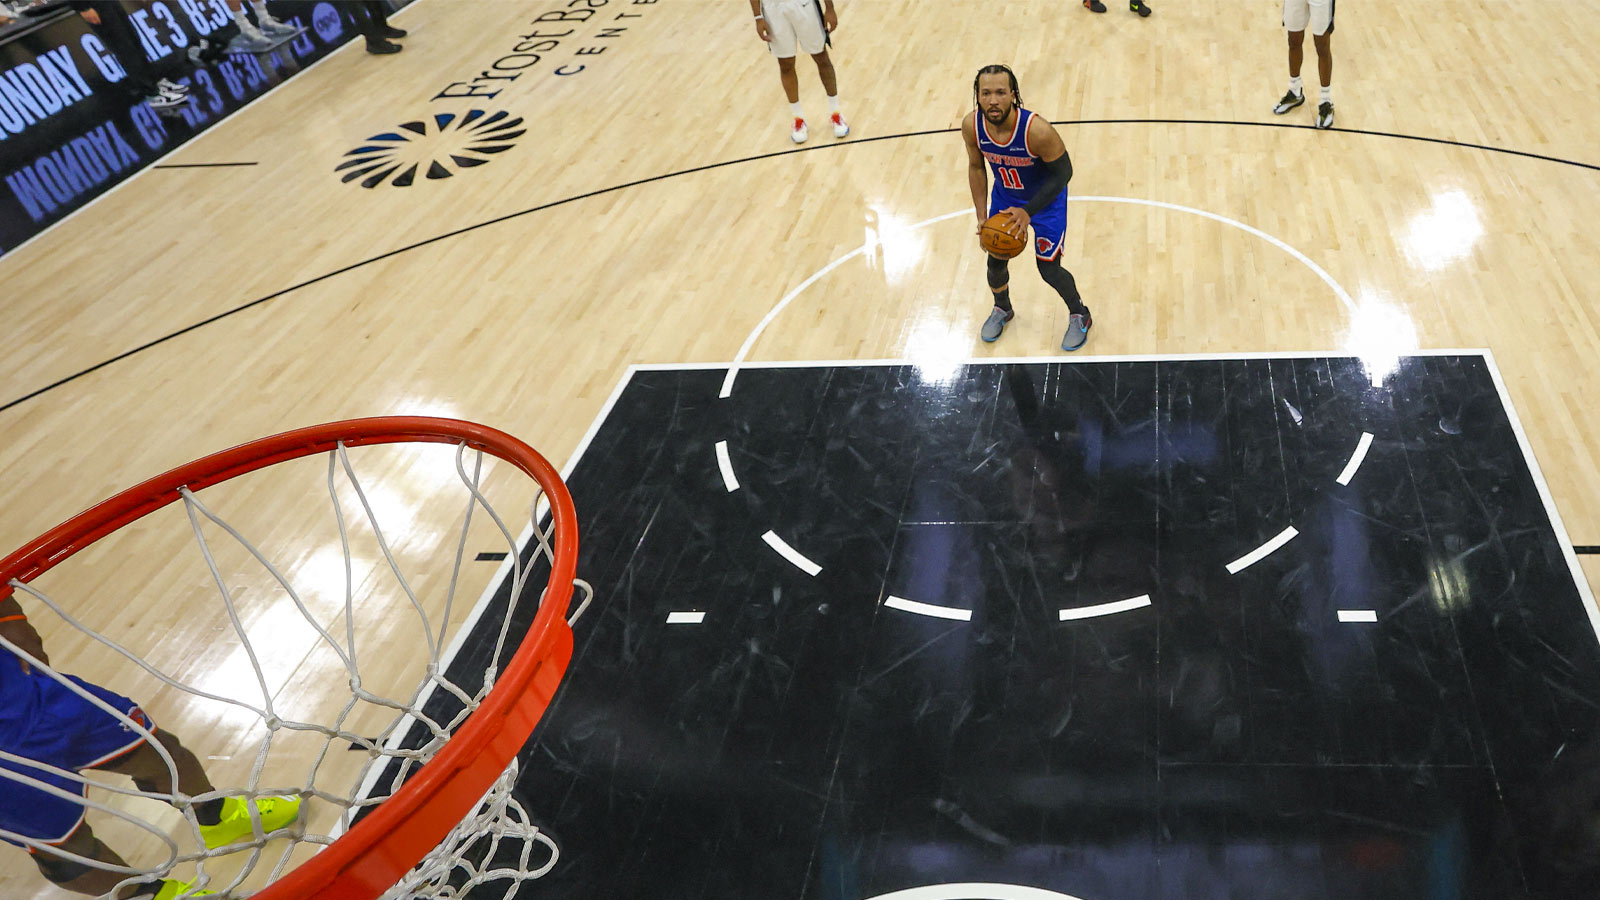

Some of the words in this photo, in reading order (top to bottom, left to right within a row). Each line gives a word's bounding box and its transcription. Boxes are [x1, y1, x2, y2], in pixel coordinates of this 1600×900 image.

[0, 44, 93, 141] ONDAY
[151, 1, 188, 48] 3
[429, 28, 575, 102] Frost
[998, 166, 1025, 190] 11
